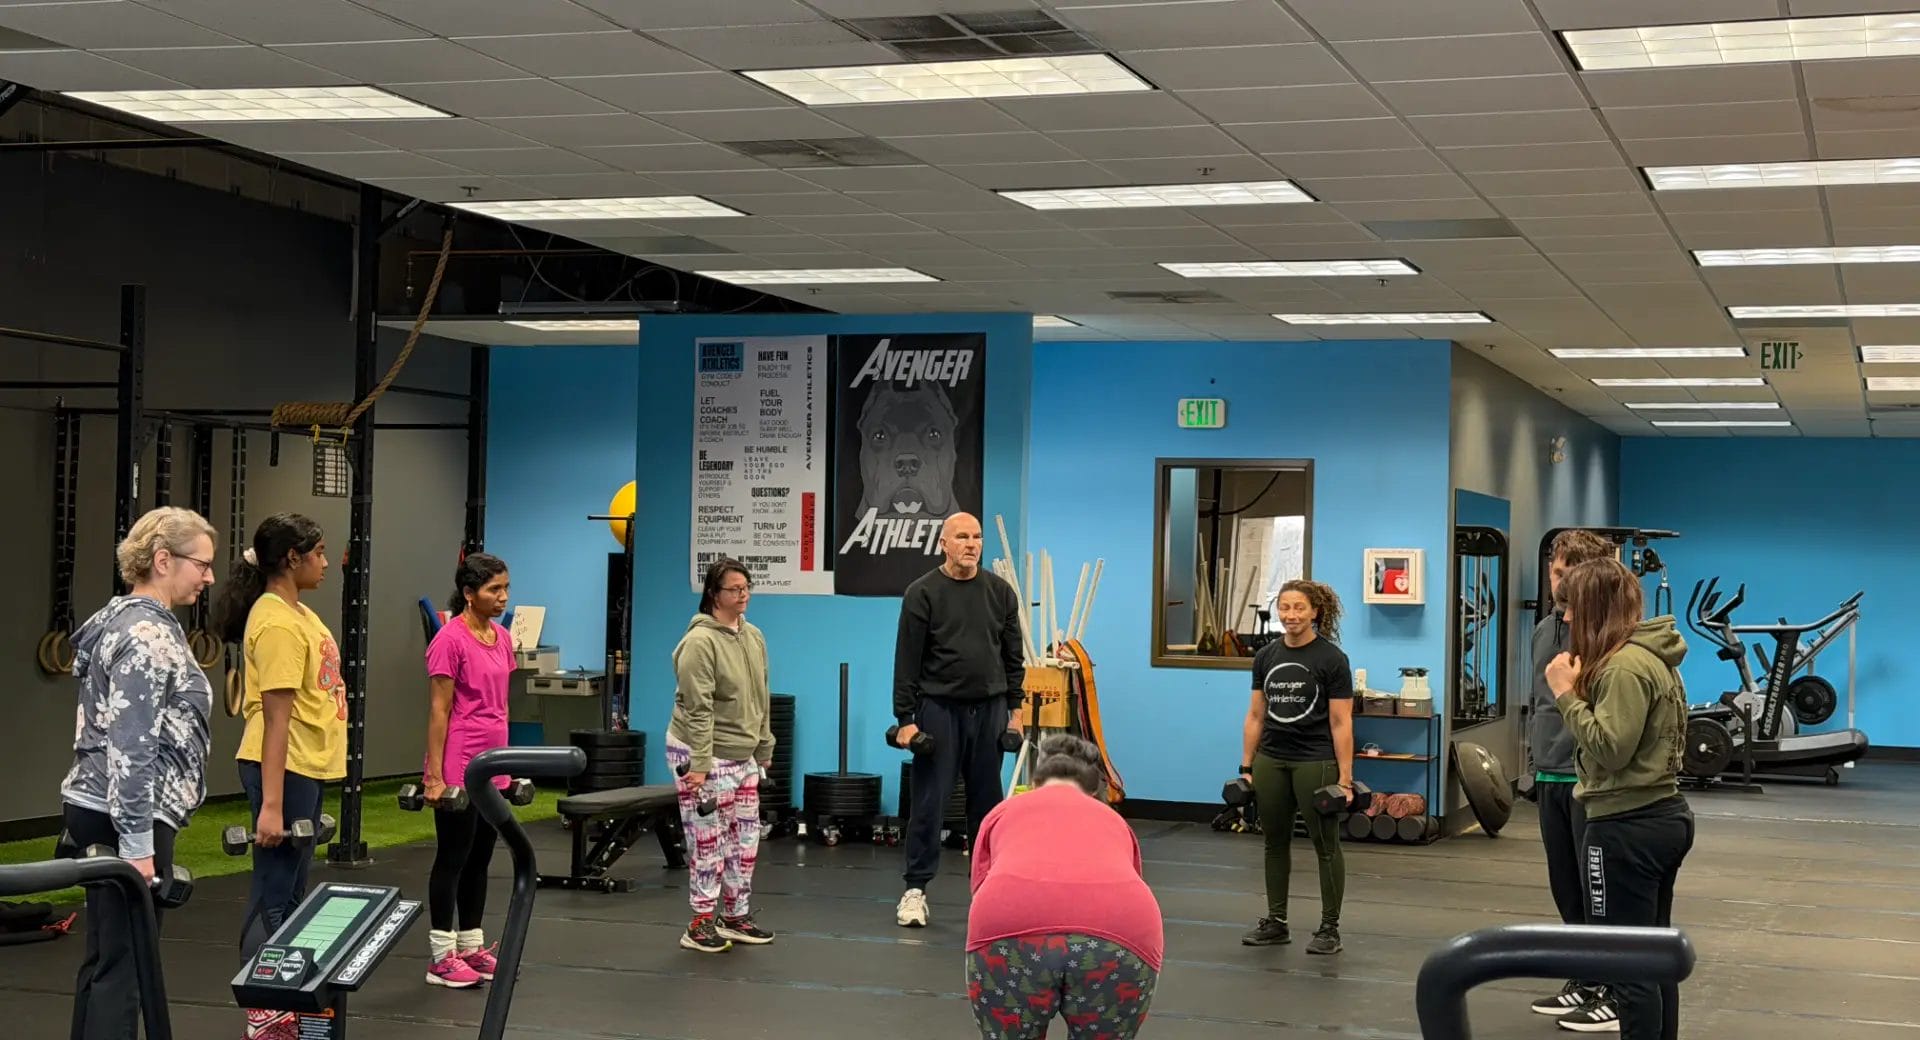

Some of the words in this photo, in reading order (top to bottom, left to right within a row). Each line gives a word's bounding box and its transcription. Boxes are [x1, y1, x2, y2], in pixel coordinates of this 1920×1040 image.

[757, 351, 775, 361] HAVE
[776, 351, 789, 361] FUN
[1761, 342, 1799, 370] EXIT
[702, 357, 741, 371] ATHLETICS
[849, 338, 975, 388] AVENGER
[760, 389, 780, 398] FUEL
[700, 396, 716, 405] LET
[760, 398, 783, 407] YOUR
[700, 406, 738, 415] COACHES
[760, 408, 783, 417] BODY
[1186, 400, 1218, 426] EXIT
[700, 416, 728, 424] COACH
[699, 449, 708, 461] BE
[744, 446, 754, 454] BE
[756, 446, 789, 454] HUMBLE
[698, 460, 735, 471] LEGENDARY
[751, 487, 791, 498] QUESTIONS?
[698, 505, 734, 514] RESPECT
[697, 515, 744, 525] EQUIPMENT
[752, 522, 775, 531] TURN
[776, 522, 788, 531] UP
[753, 539, 761, 547] BE
[762, 539, 799, 547] CONSISTENT
[697, 552, 716, 562] DON'T
[1269, 681, 1306, 693] Avenger
[1591, 849, 1602, 884] LARGE
[1593, 889, 1602, 913] LIVE
